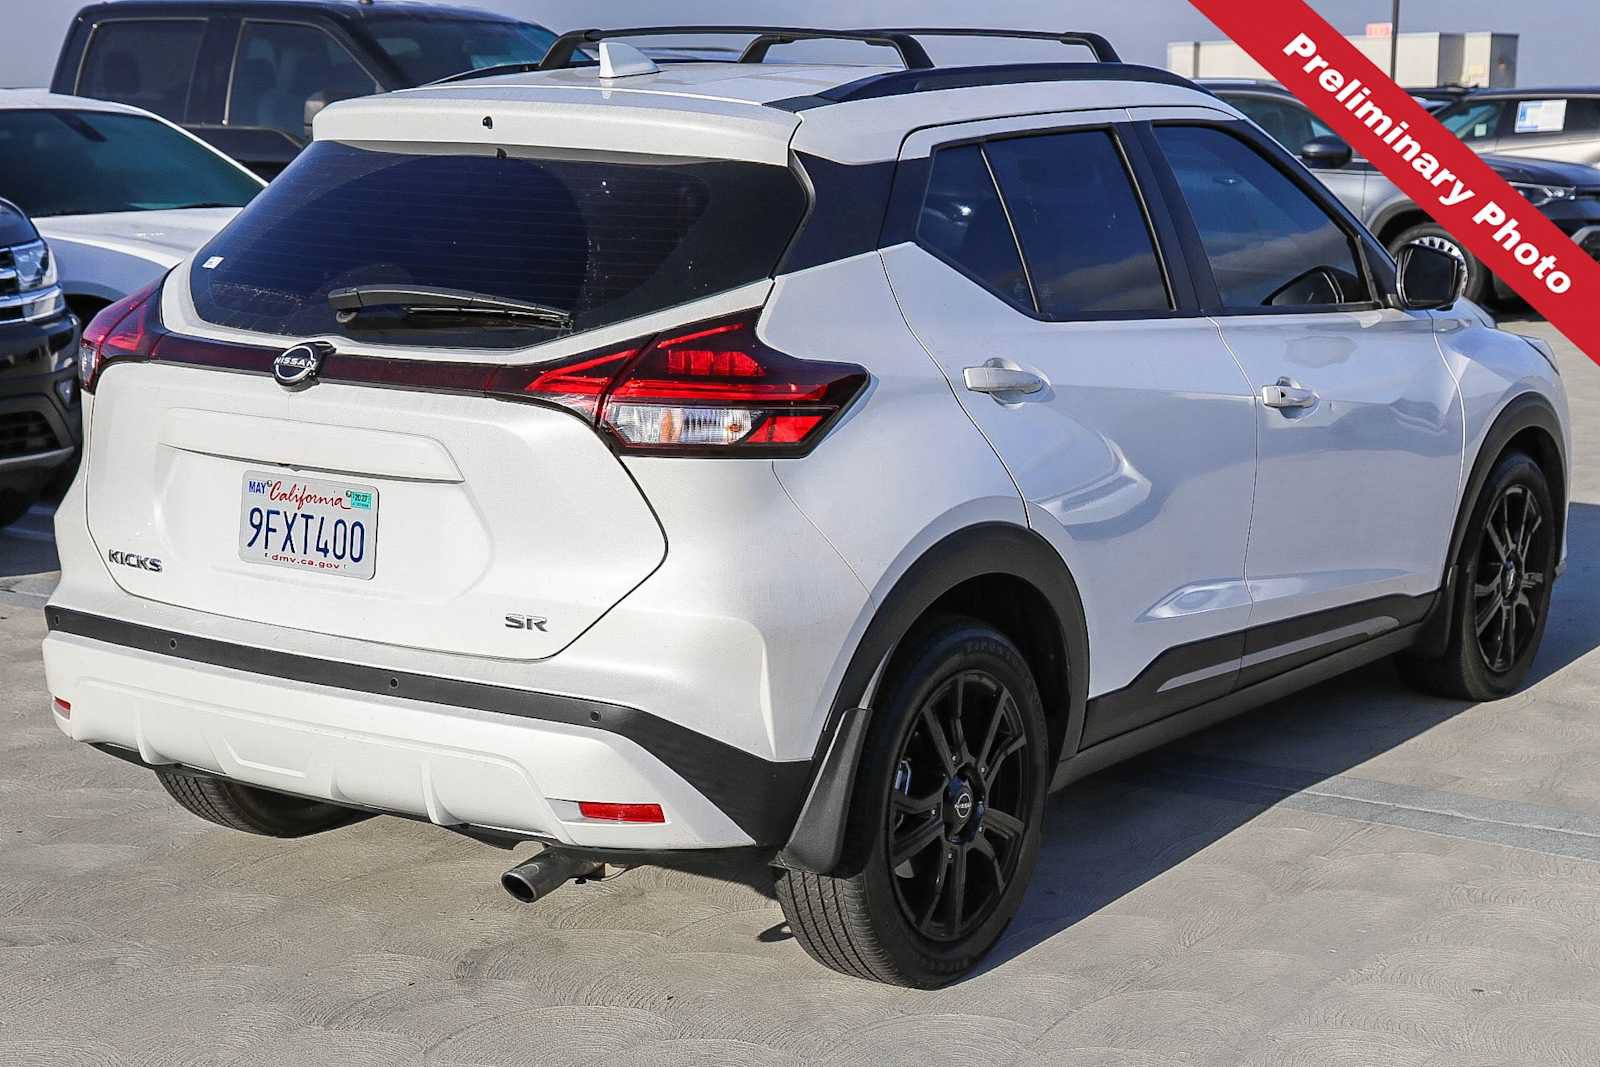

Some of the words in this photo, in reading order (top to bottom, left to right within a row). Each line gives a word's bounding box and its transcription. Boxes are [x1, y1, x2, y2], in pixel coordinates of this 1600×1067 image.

[273, 356, 316, 369] NISSAN
[248, 480, 267, 494] MAY
[269, 480, 352, 511] California
[247, 507, 365, 563] 9FXT400
[108, 549, 162, 572] KICKS
[271, 553, 340, 569] dmv.ca.gov
[505, 613, 548, 632] SR
